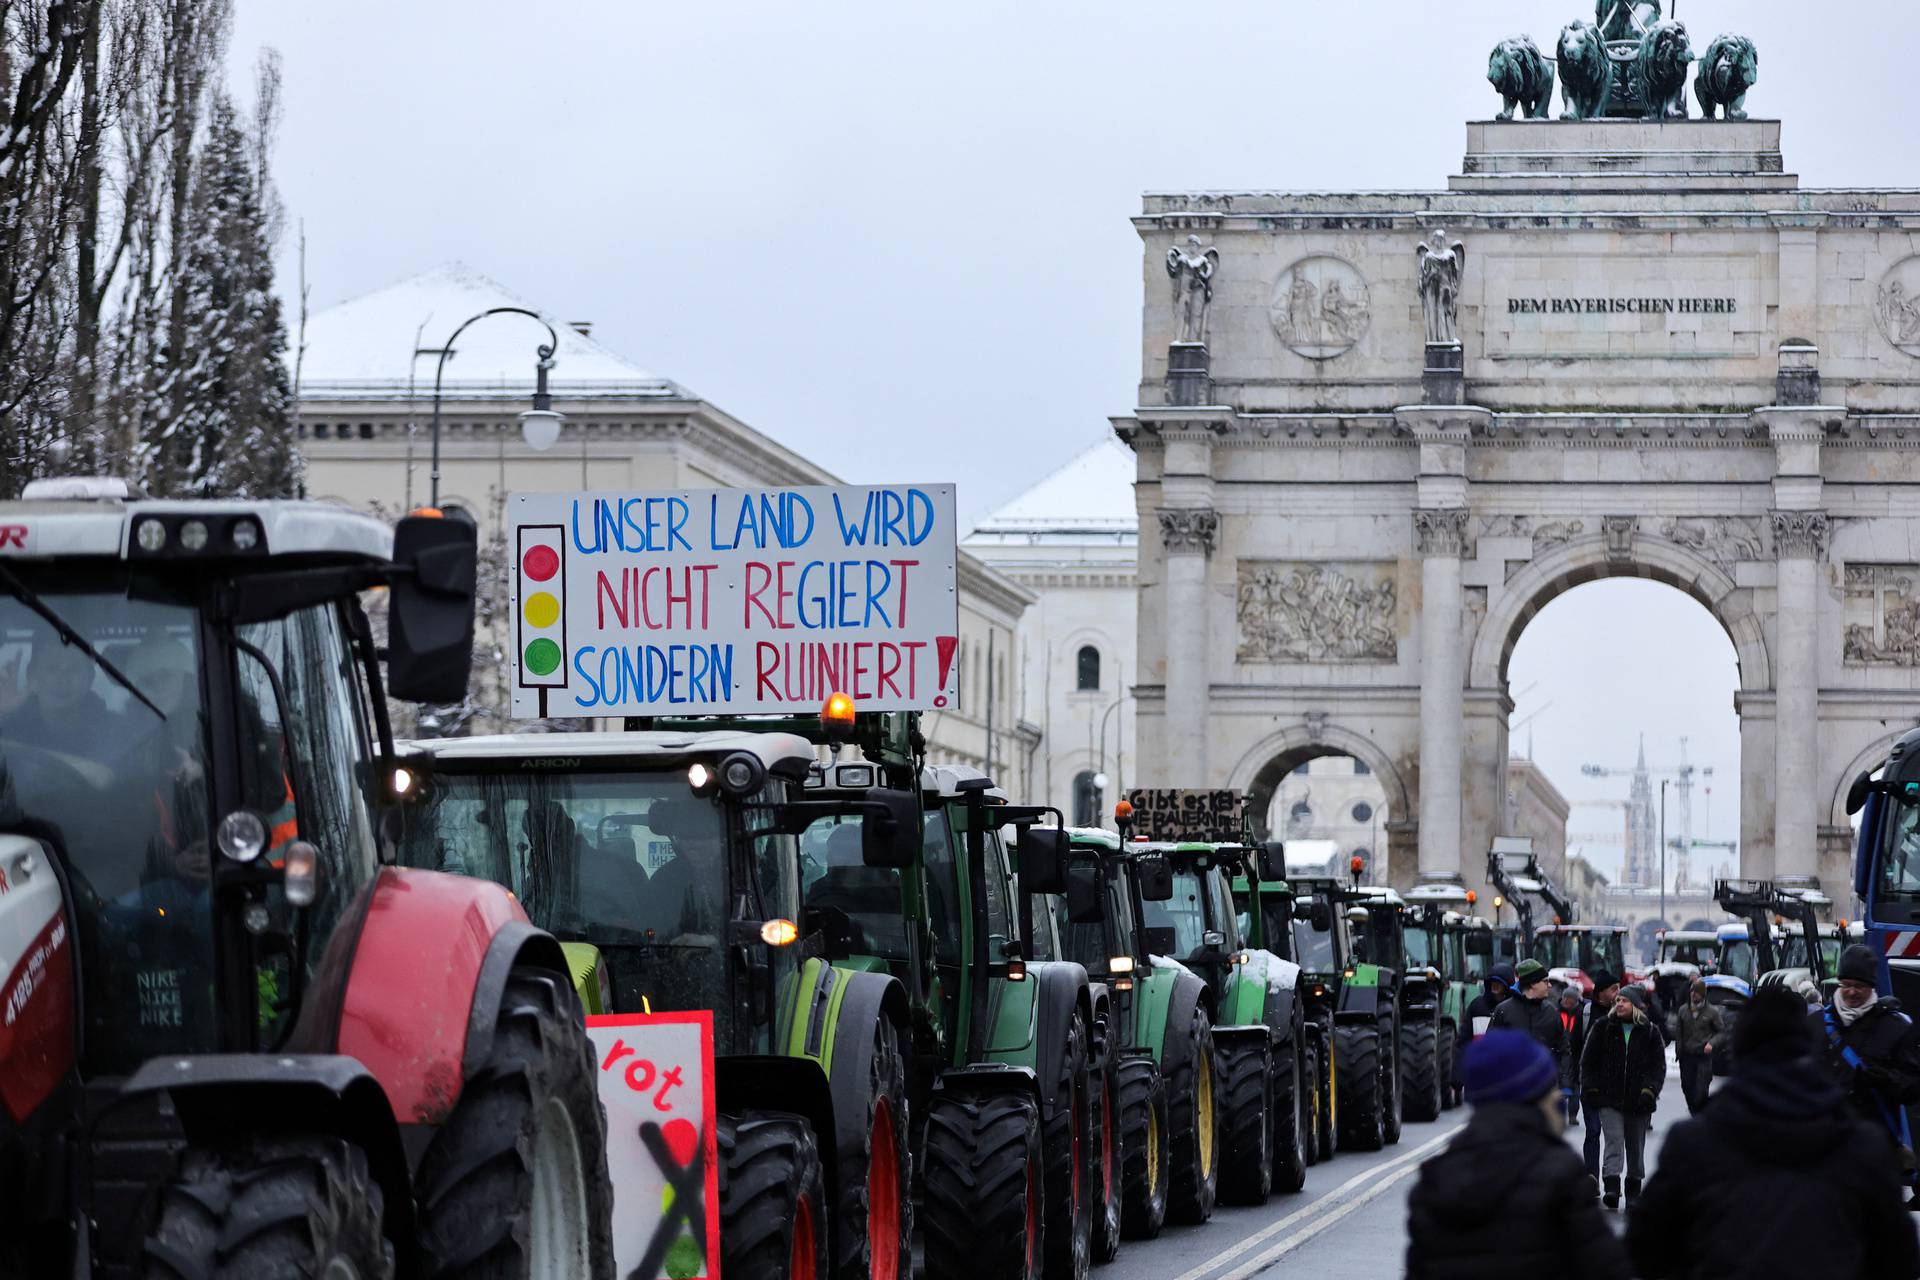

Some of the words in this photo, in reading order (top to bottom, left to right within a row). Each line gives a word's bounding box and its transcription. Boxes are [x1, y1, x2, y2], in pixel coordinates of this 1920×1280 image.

[1507, 298, 1547, 313] DEM
[1551, 298, 1674, 313] BAYERISCHEN
[1677, 298, 1737, 313] HEERE
[572, 497, 693, 553] UNSER
[711, 492, 814, 550] LAND
[833, 488, 935, 547] WIRD
[597, 564, 719, 630] NICHT
[744, 560, 919, 629] REGIERT
[574, 643, 733, 707] SONDERN
[519, 757, 582, 769] ARION
[1130, 789, 1180, 810] Gibt
[1184, 794, 1208, 811] es
[1153, 809, 1217, 828] BAUERN
[601, 1038, 684, 1112] rot
